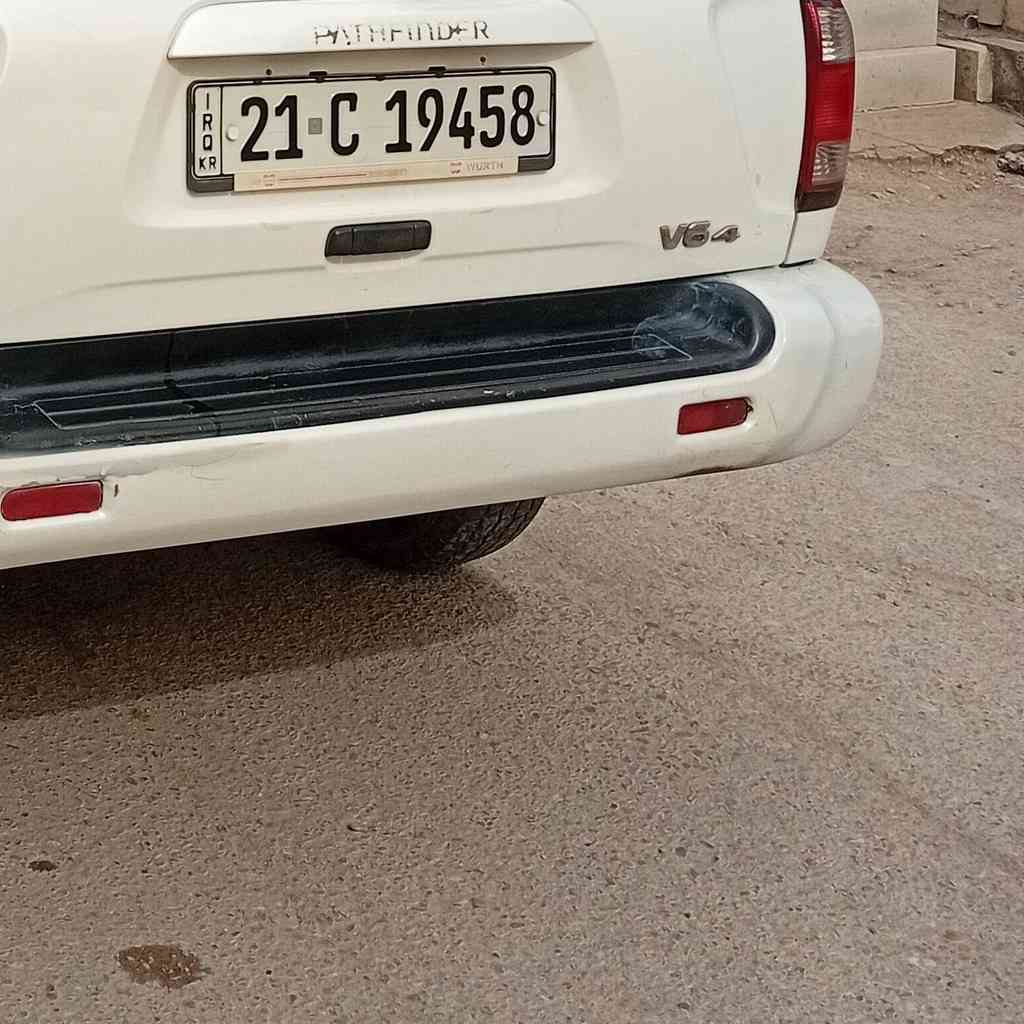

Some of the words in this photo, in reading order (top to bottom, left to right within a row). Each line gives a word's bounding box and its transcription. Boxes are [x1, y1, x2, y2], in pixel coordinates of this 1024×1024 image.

[240, 94, 304, 163] 21
[330, 92, 360, 156] C
[385, 84, 536, 154] 19458
[199, 156, 216, 170] KR
